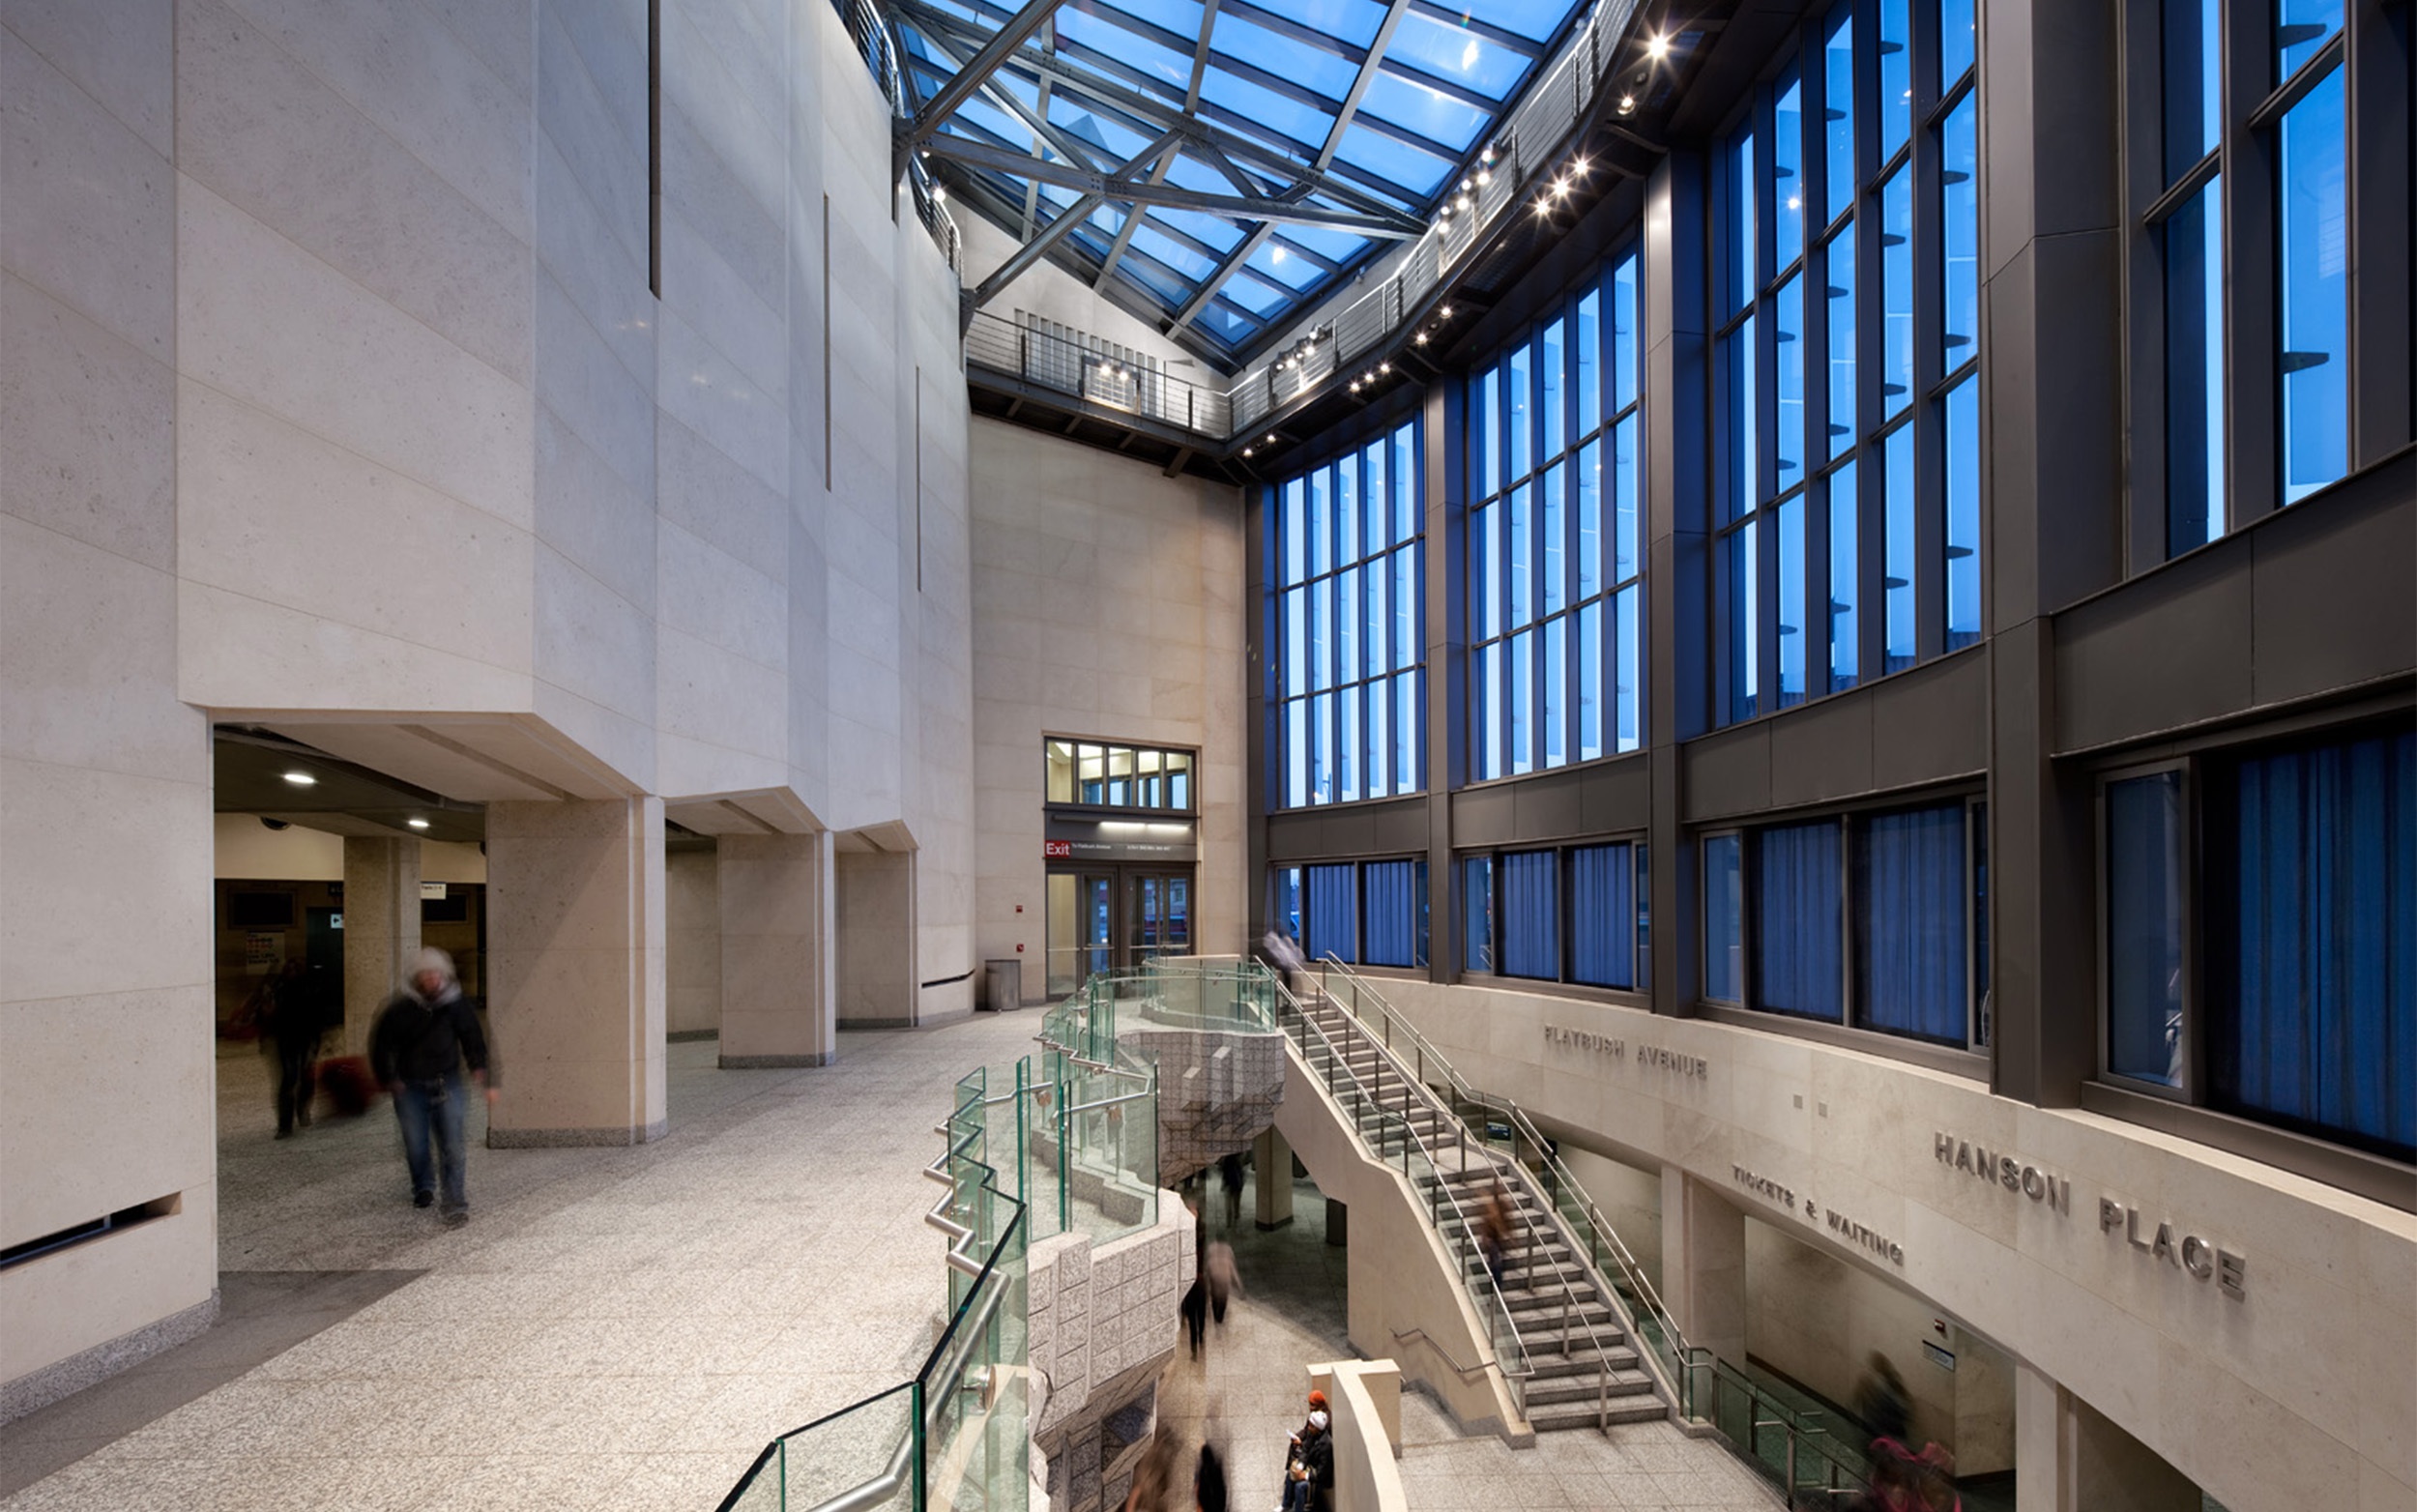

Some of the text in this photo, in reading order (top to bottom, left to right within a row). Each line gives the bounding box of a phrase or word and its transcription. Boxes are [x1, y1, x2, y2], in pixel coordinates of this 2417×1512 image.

[1046, 842, 1069, 856] Exit
[1545, 1025, 1708, 1081] FLATBUSH AVENUE
[1732, 1163, 1905, 1268] TICKETS & WAITING
[1935, 1131, 2247, 1304] HANSON PLACE
